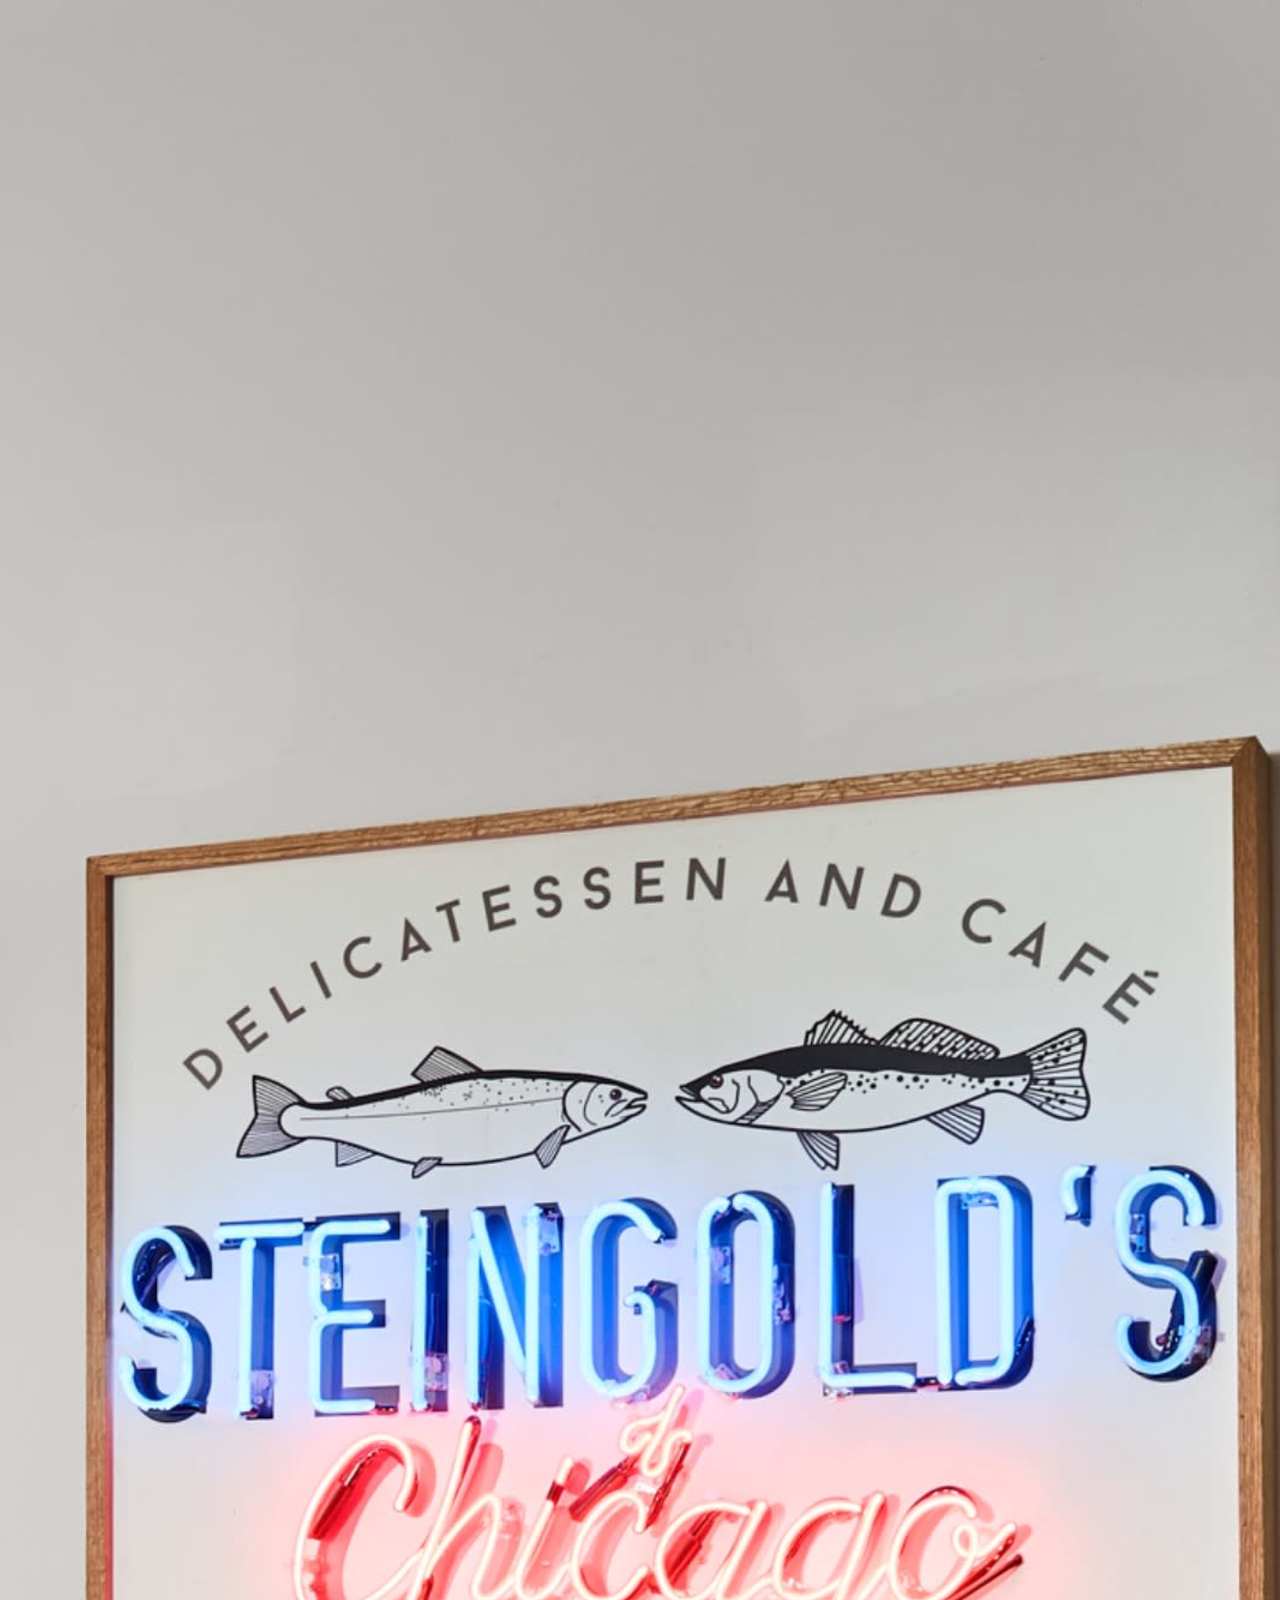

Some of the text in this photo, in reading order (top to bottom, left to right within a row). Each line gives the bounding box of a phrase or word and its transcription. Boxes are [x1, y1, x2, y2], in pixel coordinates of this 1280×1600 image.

[181, 857, 1160, 1091] DELICATESSEN AND CAFÉ
[118, 1164, 1222, 1422] STEINGOLD'S
